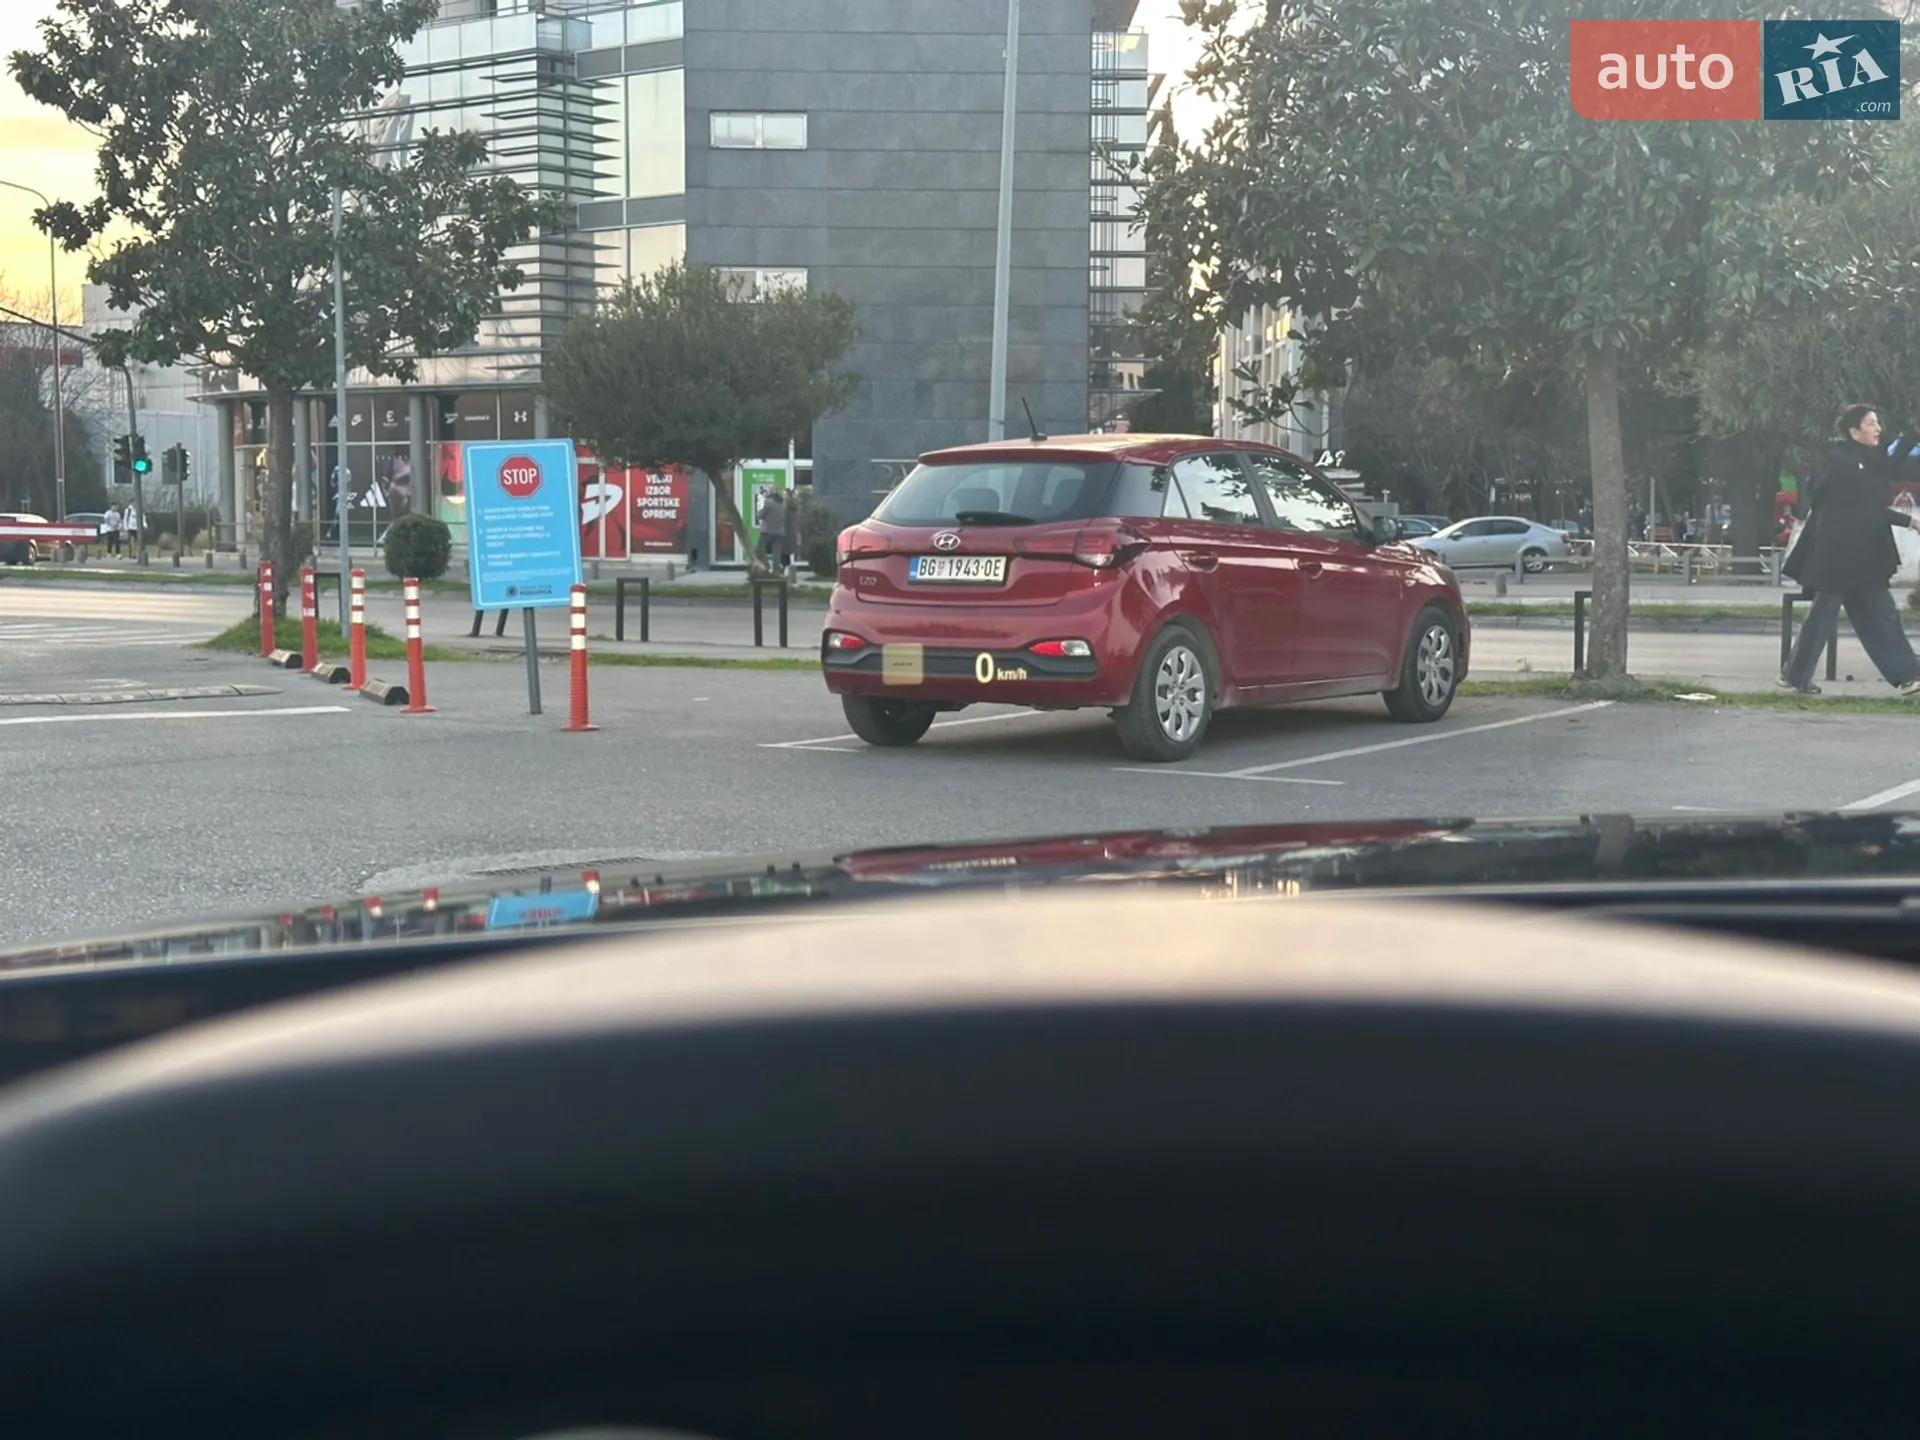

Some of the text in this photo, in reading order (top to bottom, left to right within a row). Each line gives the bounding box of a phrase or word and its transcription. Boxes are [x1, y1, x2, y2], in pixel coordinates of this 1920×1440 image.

[503, 467, 537, 486] STOP
[645, 485, 672, 496] IZBOR
[636, 497, 681, 508] SPORTSKE
[642, 509, 677, 519] OPREME
[919, 558, 936, 576] BG
[975, 652, 1027, 683] 0 km/h
